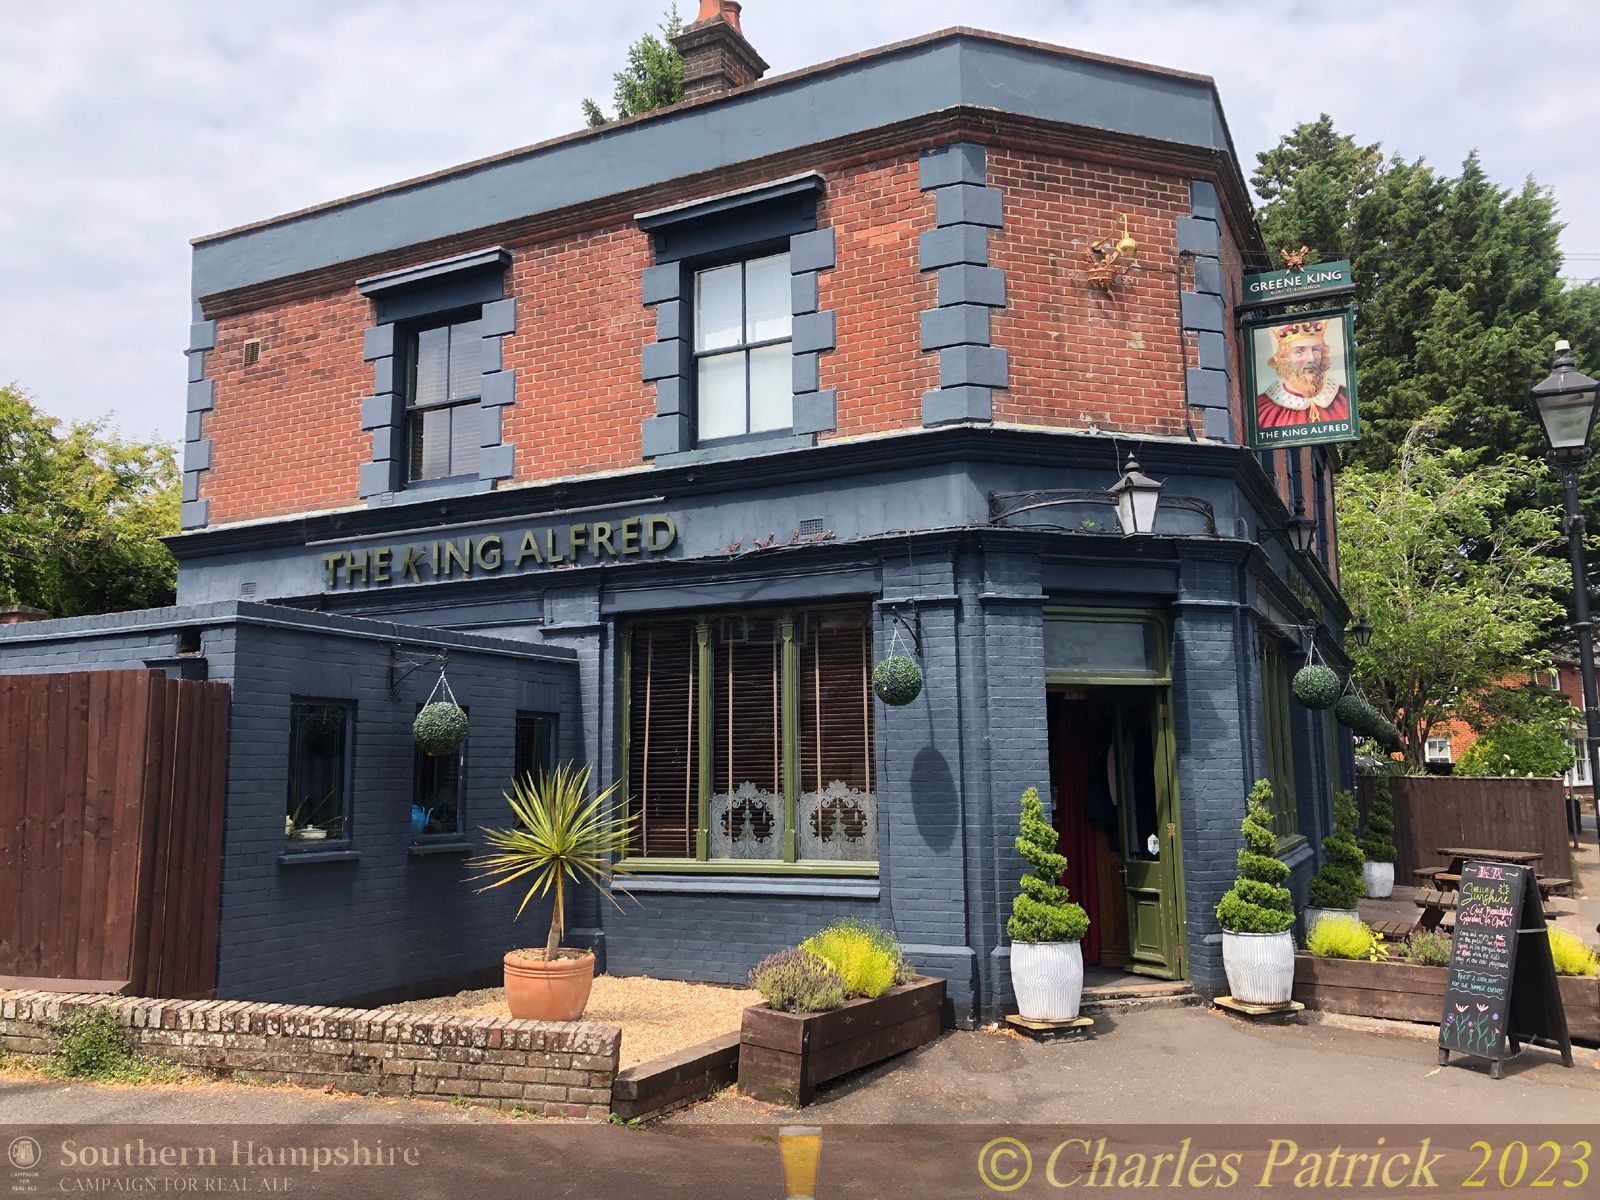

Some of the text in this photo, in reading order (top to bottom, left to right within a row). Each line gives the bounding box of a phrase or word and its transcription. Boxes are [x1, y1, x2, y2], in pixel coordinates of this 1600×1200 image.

[1250, 270, 1342, 292] GREENE KING
[1259, 423, 1349, 440] THE KING ALFRED
[320, 515, 677, 586] THE KING ALFRED
[1477, 865, 1506, 880] KA
[1460, 882, 1510, 906] Sunshine
[1459, 912, 1483, 925] Garden
[1469, 904, 1514, 919] Our Beautiful
